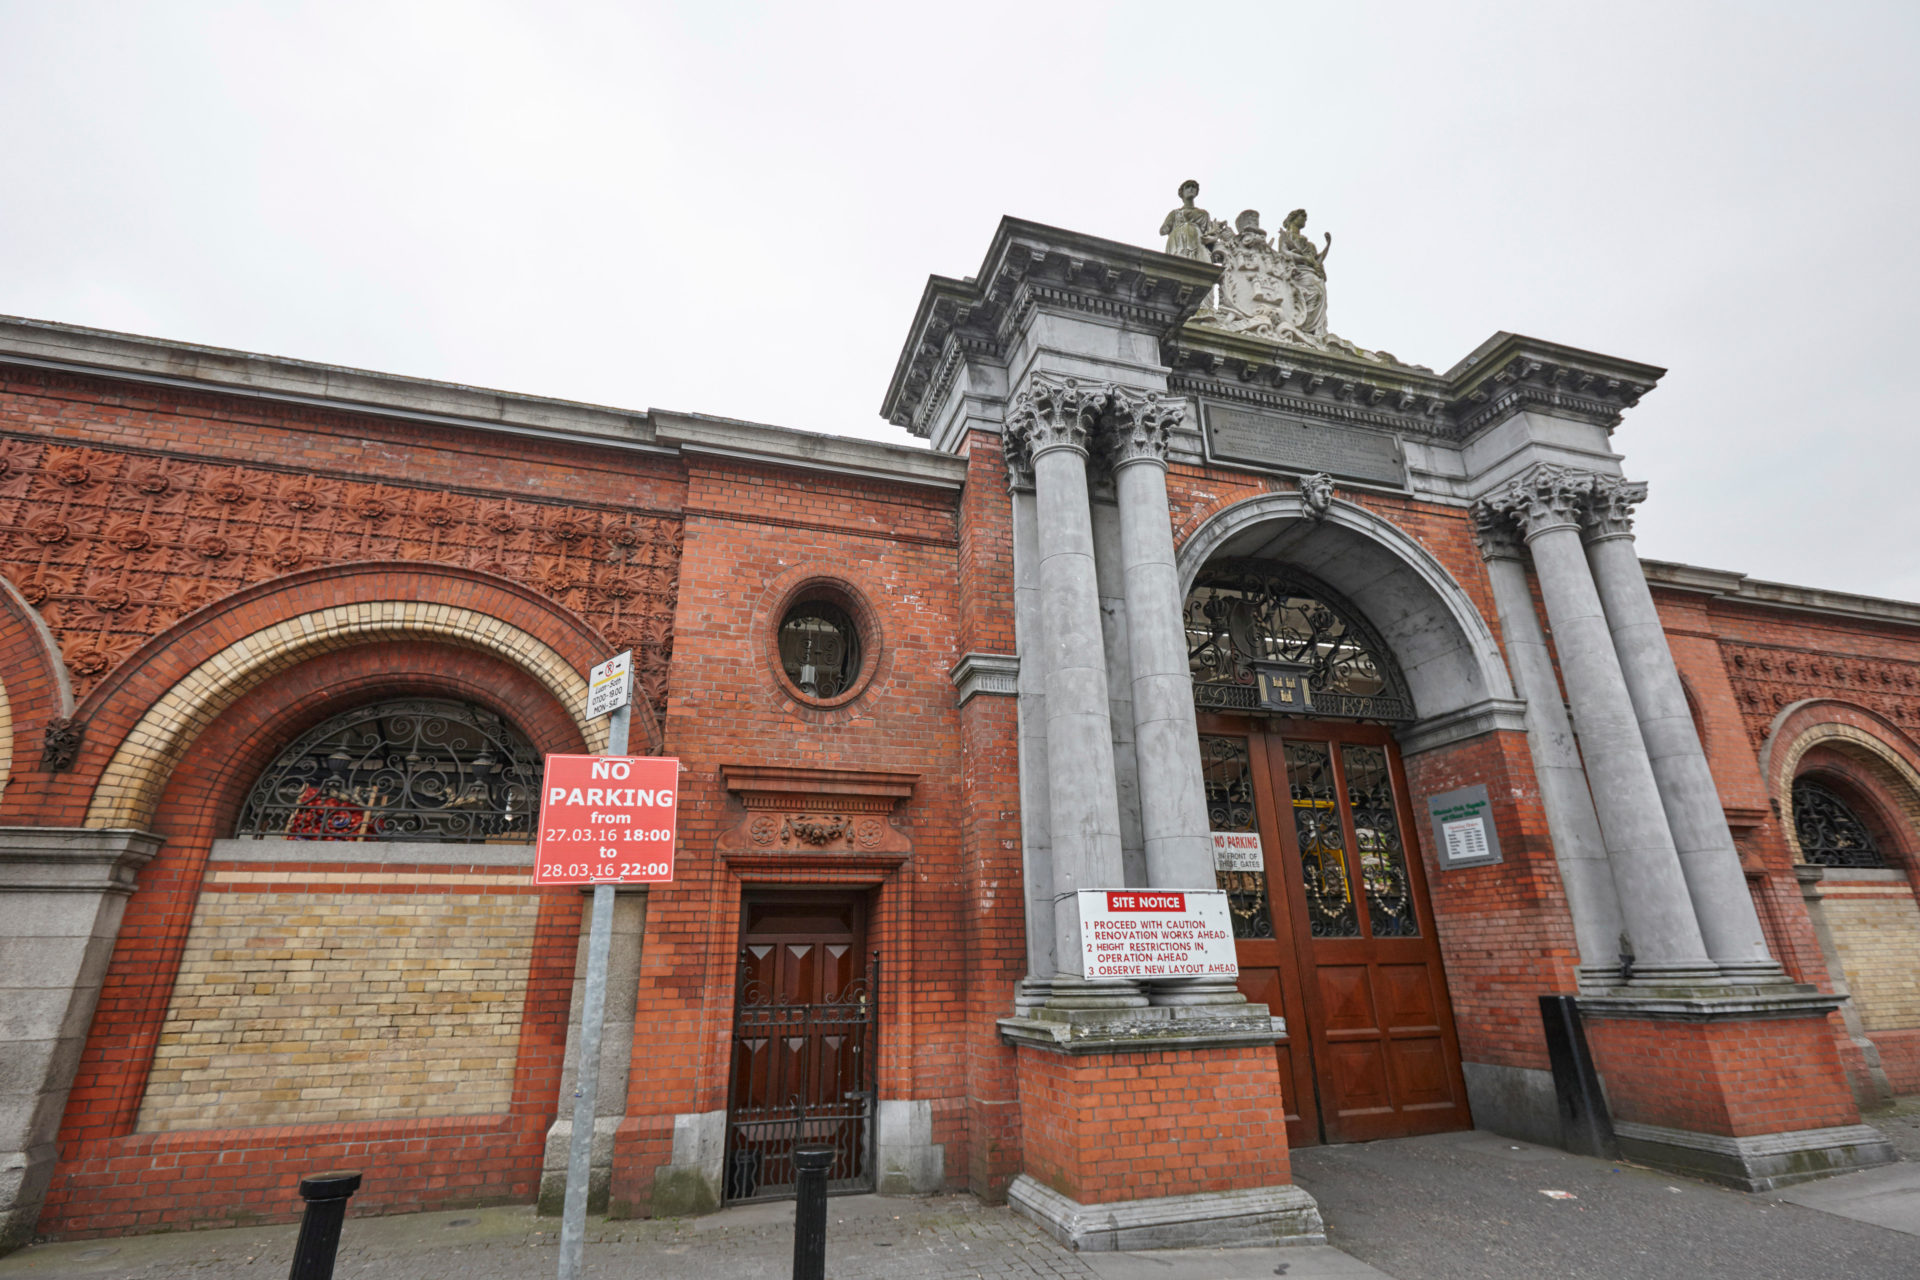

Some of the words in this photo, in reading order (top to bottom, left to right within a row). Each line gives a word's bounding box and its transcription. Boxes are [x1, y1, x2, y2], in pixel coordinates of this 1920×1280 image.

[592, 762, 630, 780] NO
[548, 787, 673, 808] PARKING
[590, 811, 631, 824] from
[546, 828, 618, 842] 27.03.16
[623, 829, 670, 842] 18:00
[1214, 836, 1224, 848] NO
[1227, 836, 1258, 848] PARKING
[599, 846, 618, 858] to
[542, 864, 614, 877] 28.03.16
[620, 863, 668, 876] 22:00
[1112, 896, 1135, 908] SITE
[1140, 897, 1180, 908] NOTICE
[1085, 921, 1089, 930] 1
[1094, 920, 1137, 930] PROCEED
[1140, 920, 1163, 929] WITH
[1166, 920, 1206, 929] CAUTION
[1095, 931, 1158, 940] RENOVATION
[1161, 930, 1194, 939] WORKS
[1197, 930, 1226, 939] AHEAD
[1086, 944, 1093, 952] 2
[1096, 943, 1124, 951] HEIGHT
[1130, 942, 1192, 952] RESTRICTIONS
[1194, 942, 1204, 951] IN
[1098, 954, 1152, 963] OPERATION
[1157, 953, 1188, 962] AHEAD
[1088, 966, 1095, 975] 3
[1098, 966, 1141, 975] OBSERVE
[1144, 965, 1165, 974] NEW
[1168, 964, 1204, 973] LAYOUT
[1208, 964, 1236, 972] AHEAD
